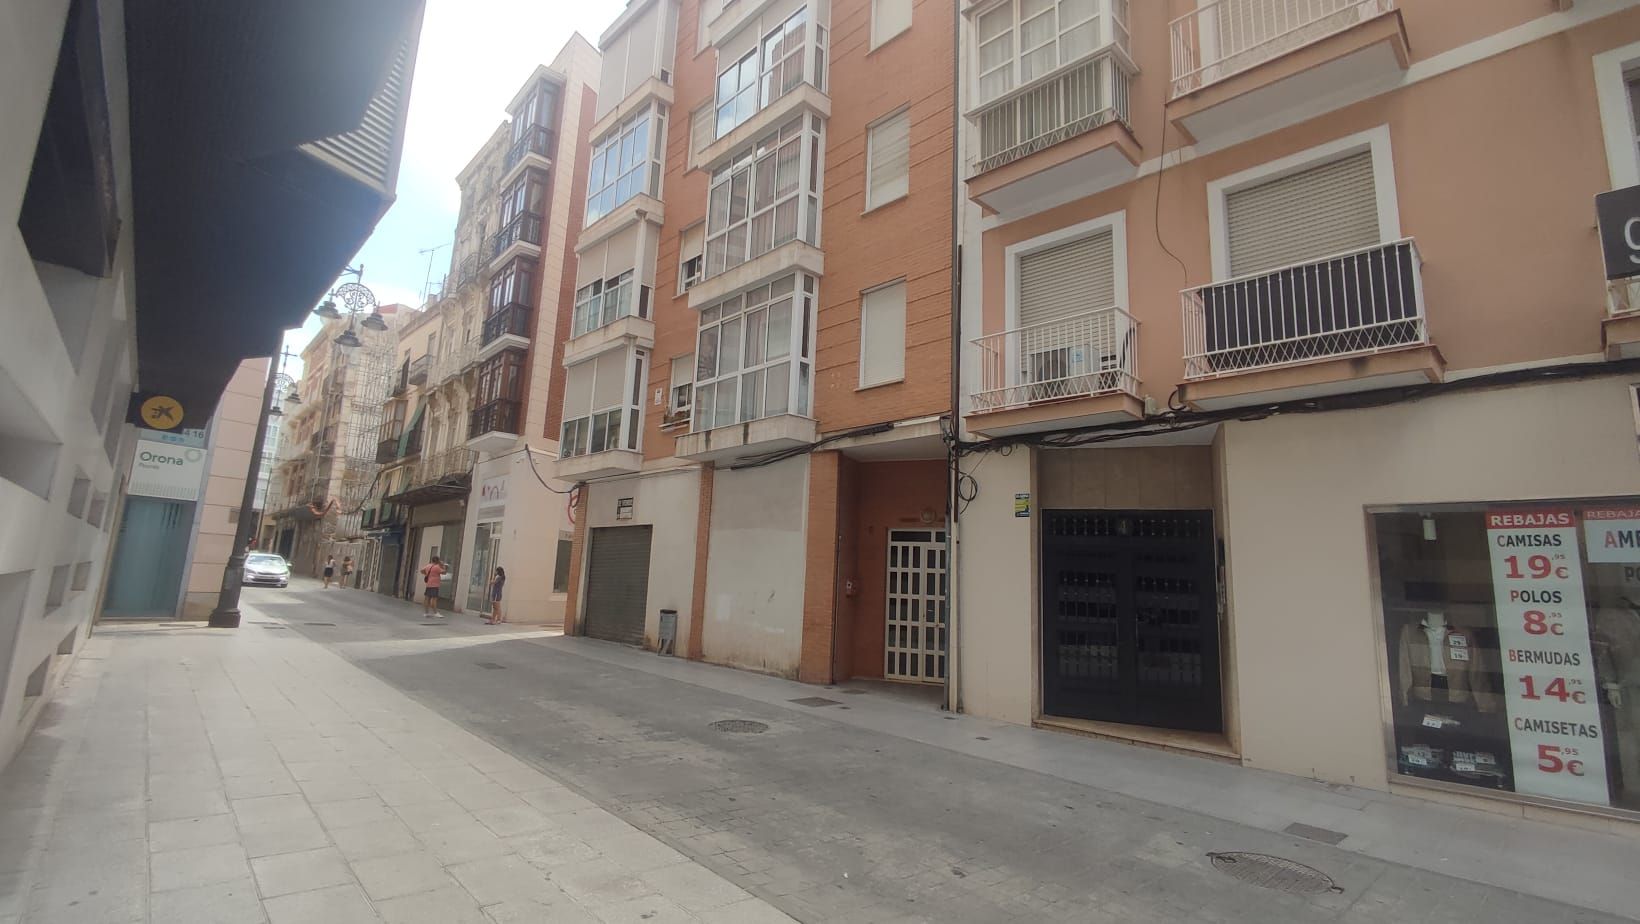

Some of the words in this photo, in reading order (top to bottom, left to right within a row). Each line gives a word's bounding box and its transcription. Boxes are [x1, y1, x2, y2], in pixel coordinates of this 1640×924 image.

[140, 451, 184, 466] Orona
[1491, 513, 1570, 526] REBAJAS
[1497, 534, 1562, 547] CAMISAS
[1510, 590, 1562, 603] POLOS
[1509, 649, 1580, 666] BERMUDAS
[1515, 717, 1598, 738] CAMISETAS
